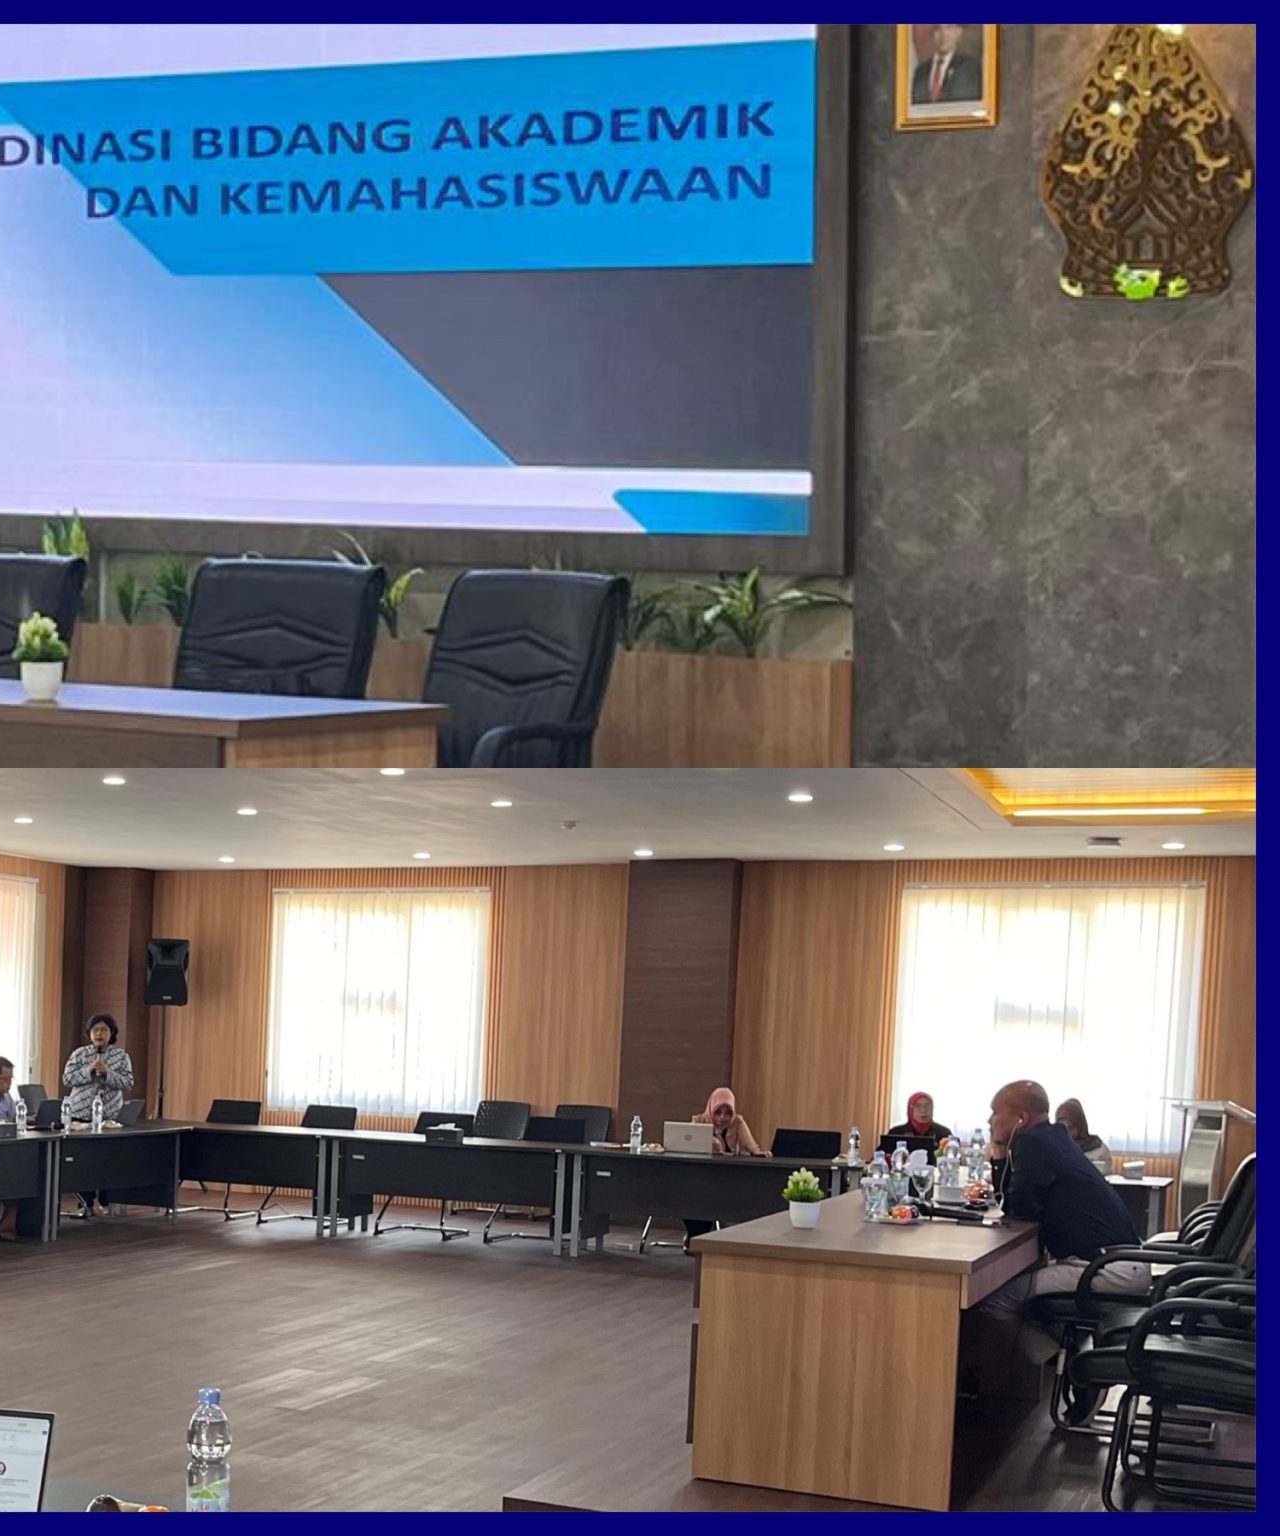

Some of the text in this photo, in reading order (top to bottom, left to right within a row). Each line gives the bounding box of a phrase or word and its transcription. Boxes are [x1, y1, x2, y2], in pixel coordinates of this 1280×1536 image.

[192, 118, 412, 160] BIDANG
[432, 101, 774, 151] AKADEMIK
[86, 162, 772, 219] DAN KEMAHASISWAAN
